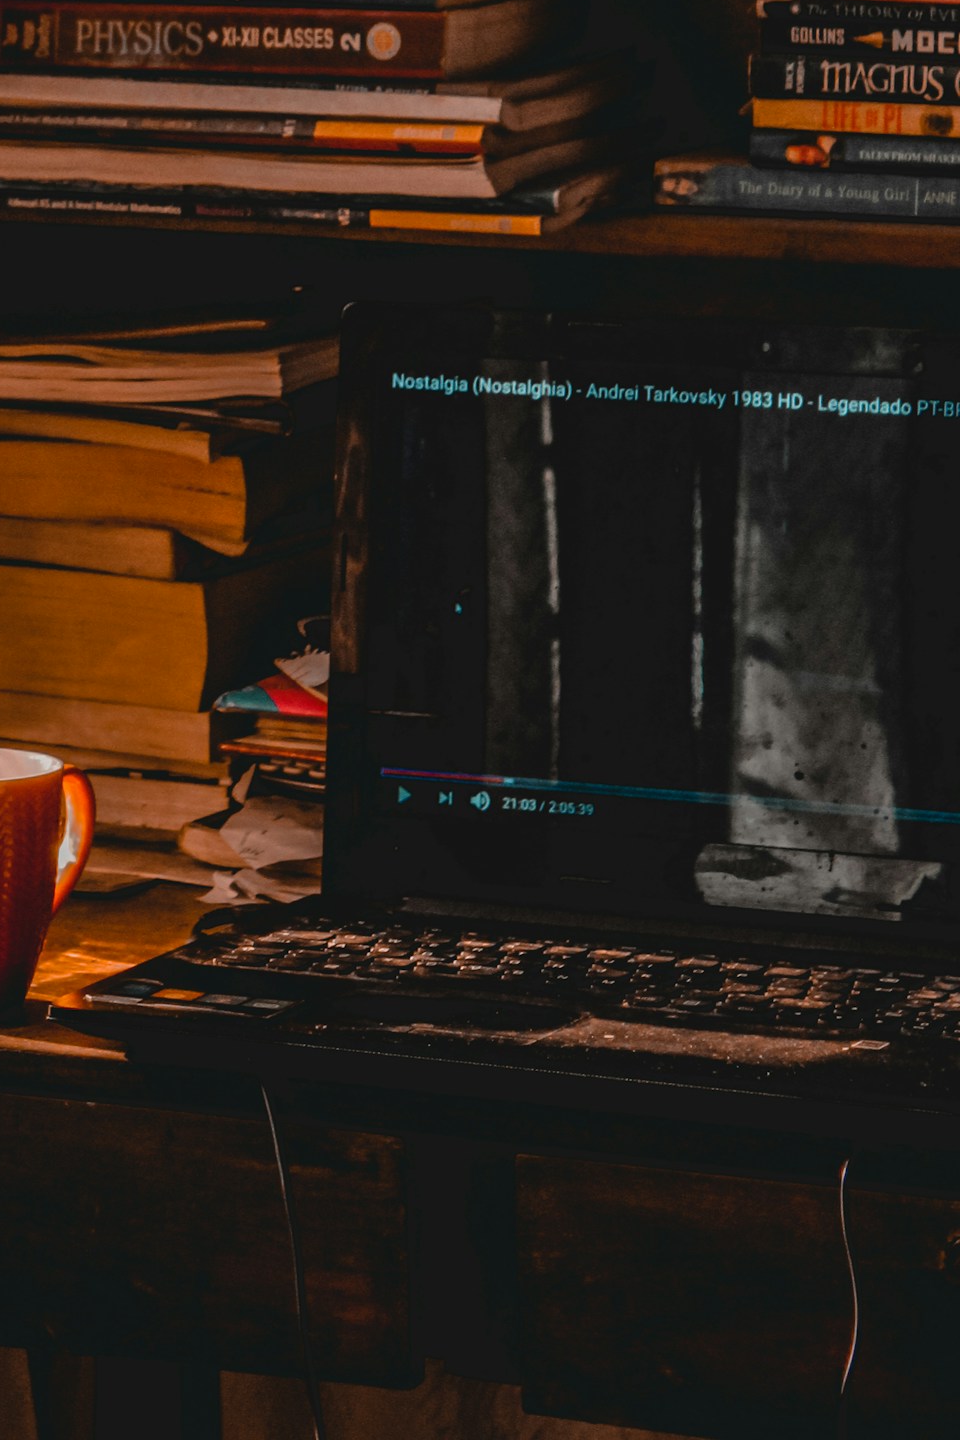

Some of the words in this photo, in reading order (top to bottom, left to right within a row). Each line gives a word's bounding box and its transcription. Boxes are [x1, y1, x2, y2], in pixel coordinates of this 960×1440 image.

[833, 3, 902, 19] THEORY
[75, 19, 205, 57] PHYSICS
[221, 26, 259, 48] XI-XII
[263, 26, 334, 50] CLASSES
[340, 33, 361, 52] 2
[892, 28, 960, 54] MOC
[822, 101, 861, 130] LIFE
[883, 103, 902, 134] PI
[739, 180, 762, 195] The
[768, 182, 803, 199] Diary
[807, 182, 821, 197] of
[825, 187, 833, 197] a
[838, 185, 879, 203] Young
[884, 187, 910, 202] Girl
[924, 191, 957, 206] ANNE
[392, 372, 468, 395] Nostalgia
[473, 375, 573, 401] (Nostalghia)
[586, 382, 639, 401] Andrei
[643, 384, 727, 410] Tarkovsky
[732, 389, 773, 409] 1983
[778, 391, 804, 411] HD
[818, 394, 912, 417] Legendado
[502, 796, 537, 811] 21:03
[549, 800, 594, 816] 2:05:39
